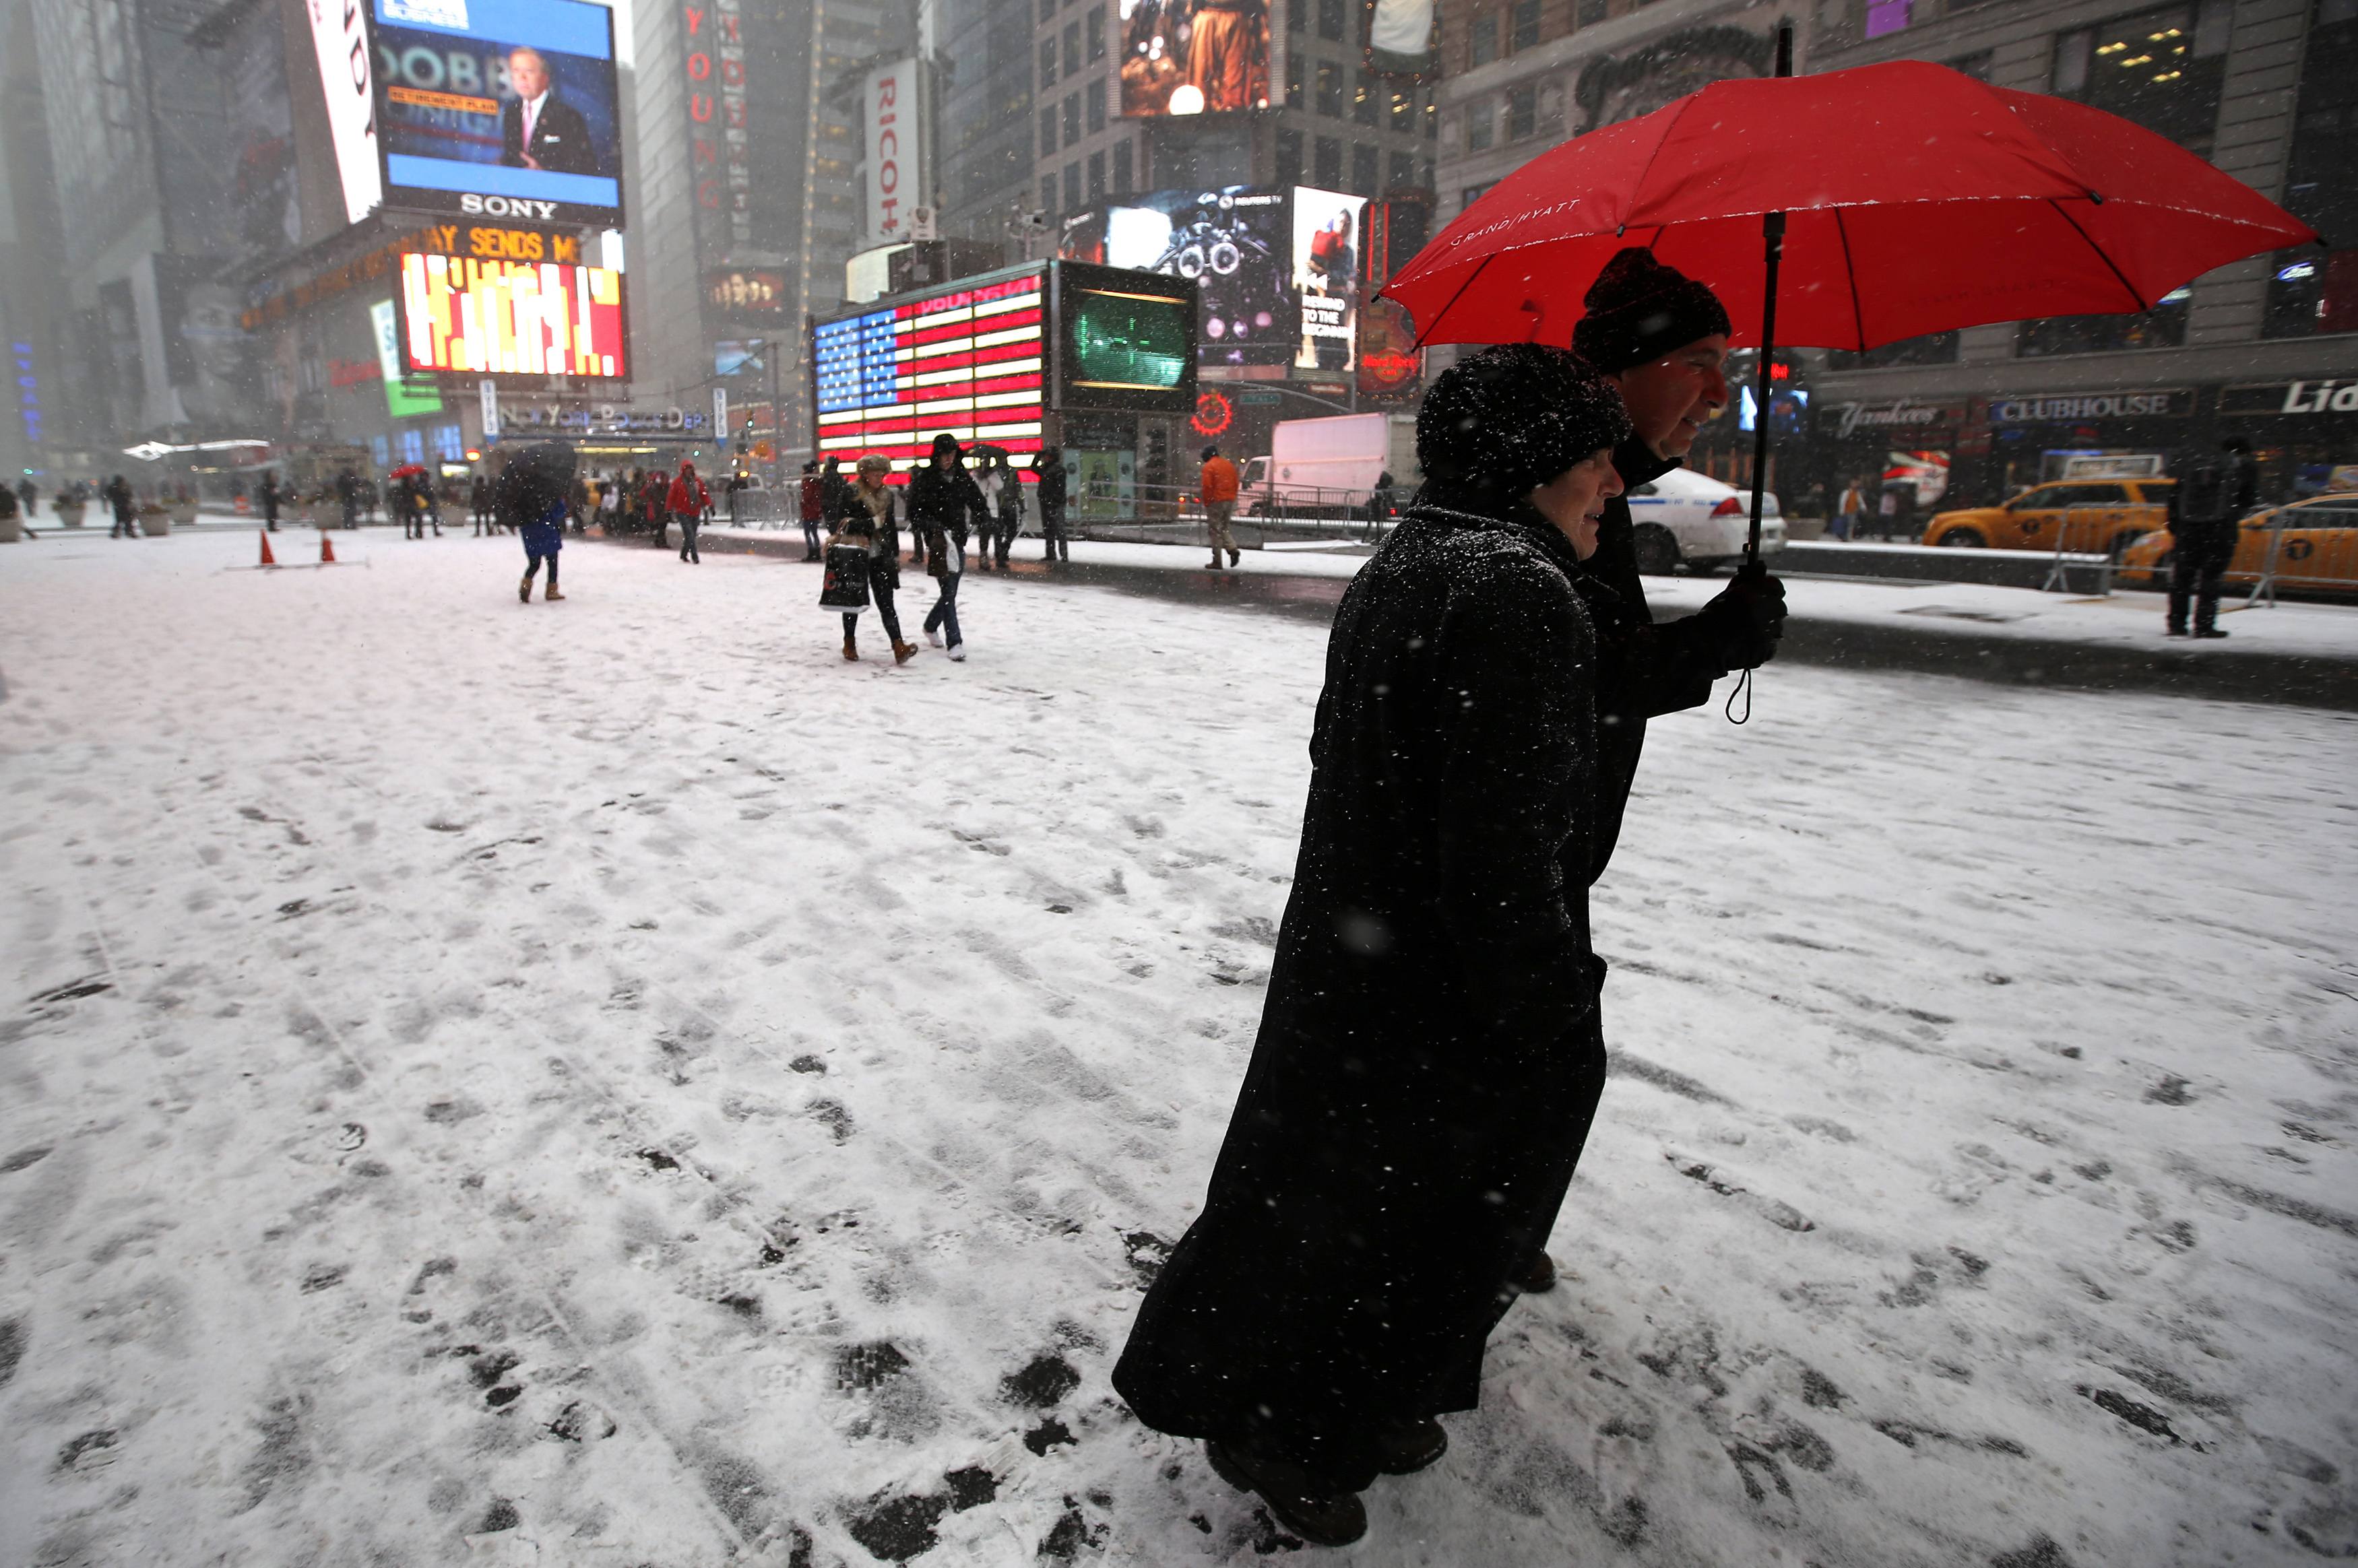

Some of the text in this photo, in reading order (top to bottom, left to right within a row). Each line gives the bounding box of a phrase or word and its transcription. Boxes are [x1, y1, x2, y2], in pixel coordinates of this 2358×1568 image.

[685, 6, 720, 209] YOUNG
[879, 75, 899, 230] RICOH
[460, 193, 559, 221] SONY
[470, 227, 544, 260] SENDS
[1302, 308, 1339, 325] TO THE
[1836, 397, 1940, 439] Yankees
[2000, 394, 2170, 422] CLUBHOUSE
